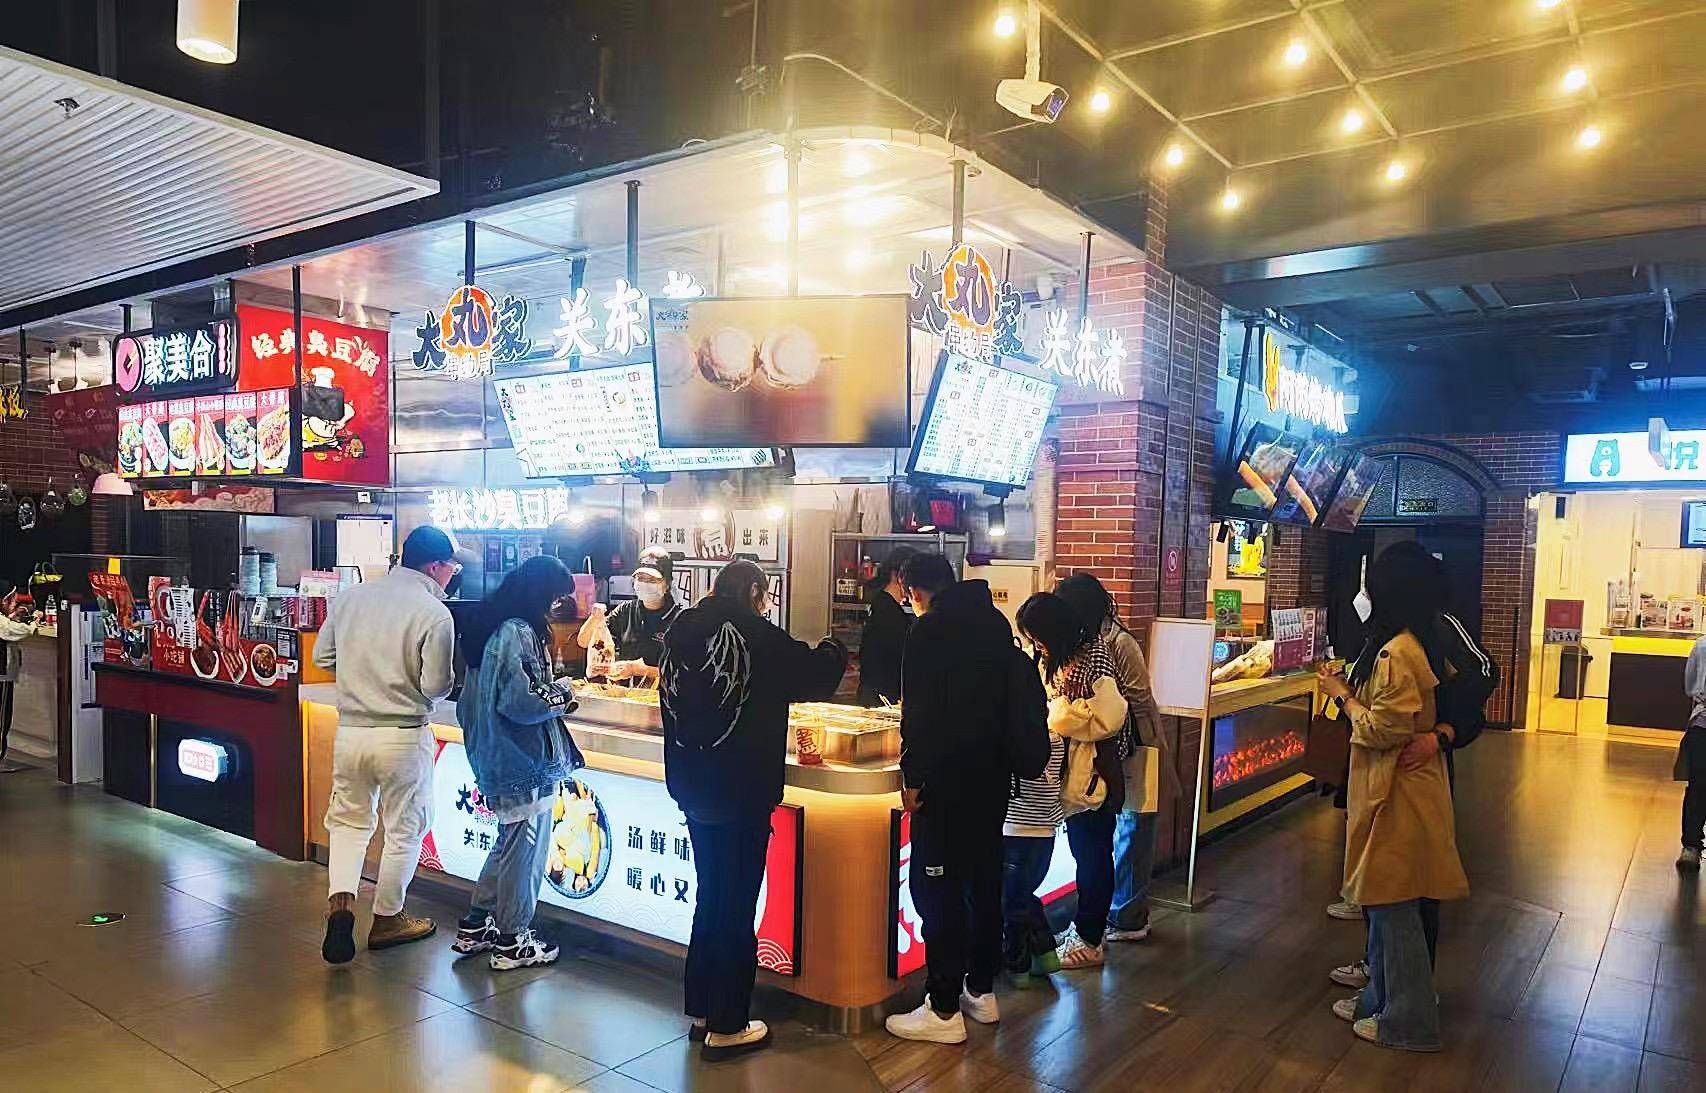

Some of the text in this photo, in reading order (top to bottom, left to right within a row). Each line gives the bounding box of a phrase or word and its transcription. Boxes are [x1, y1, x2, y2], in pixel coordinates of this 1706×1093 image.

[144, 329, 213, 385] 聚美合
[628, 825, 690, 862] 汤鲜味
[627, 866, 689, 904] 暖心又
